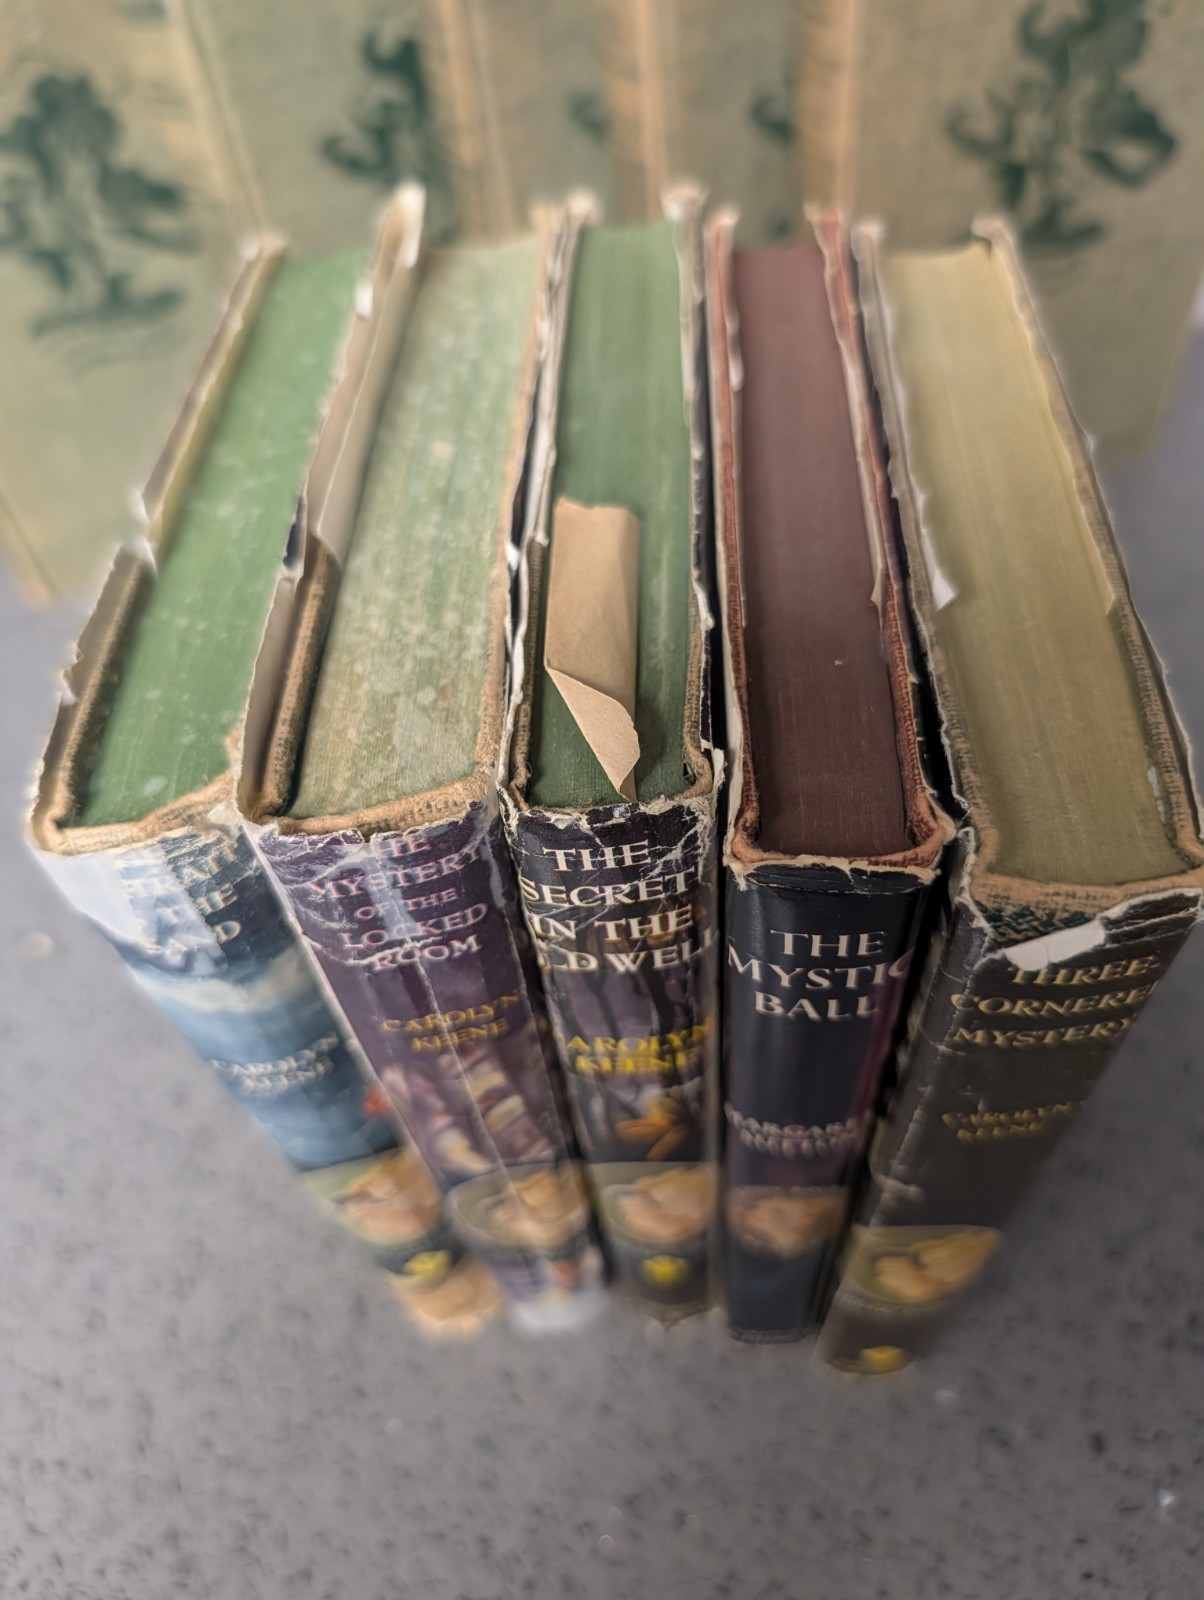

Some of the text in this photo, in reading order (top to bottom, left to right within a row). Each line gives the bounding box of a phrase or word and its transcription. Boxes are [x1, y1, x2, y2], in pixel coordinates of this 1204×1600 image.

[543, 839, 651, 872] THE
[404, 886, 459, 911] THE
[519, 868, 695, 907] SECRET
[340, 902, 488, 949] LOCKED
[530, 903, 693, 942] IN THE
[374, 934, 482, 973] ROOM
[770, 929, 886, 957] THE
[1007, 954, 1161, 985] THREE
[755, 990, 878, 1021] BALL
